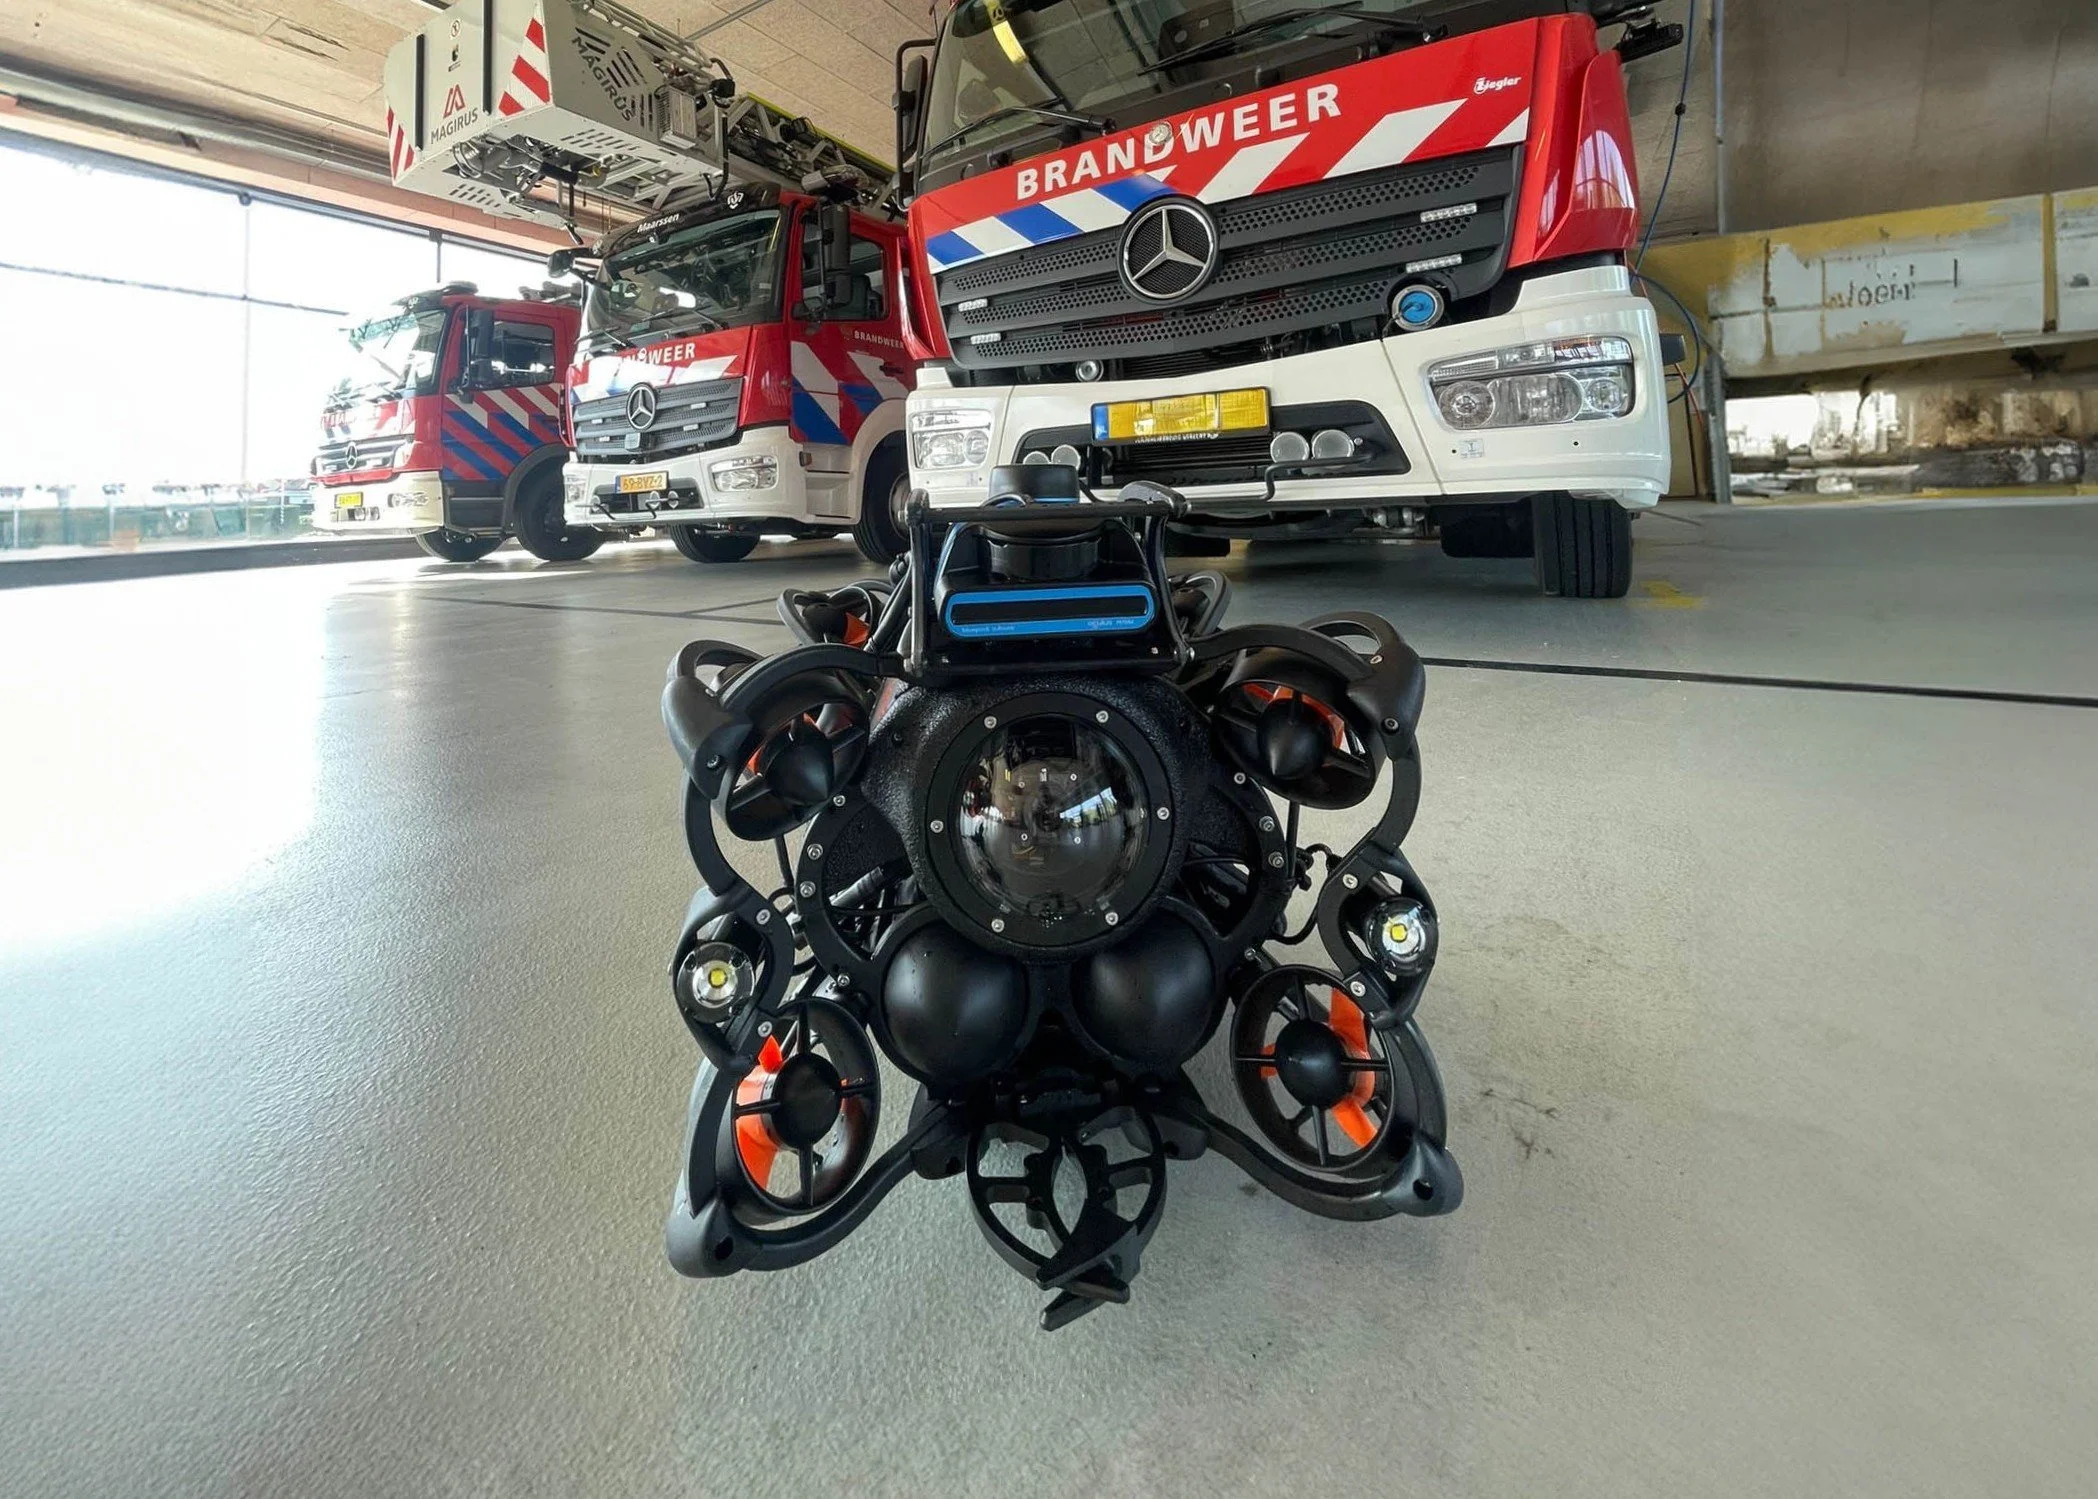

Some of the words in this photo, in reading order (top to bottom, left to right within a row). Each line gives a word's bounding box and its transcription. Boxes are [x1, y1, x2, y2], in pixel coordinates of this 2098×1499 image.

[571, 36, 636, 121] MAGIRUS
[430, 107, 478, 144] MAGIRUS
[1016, 83, 1342, 200] BRANDWEER
[637, 213, 680, 233] Maarssen
